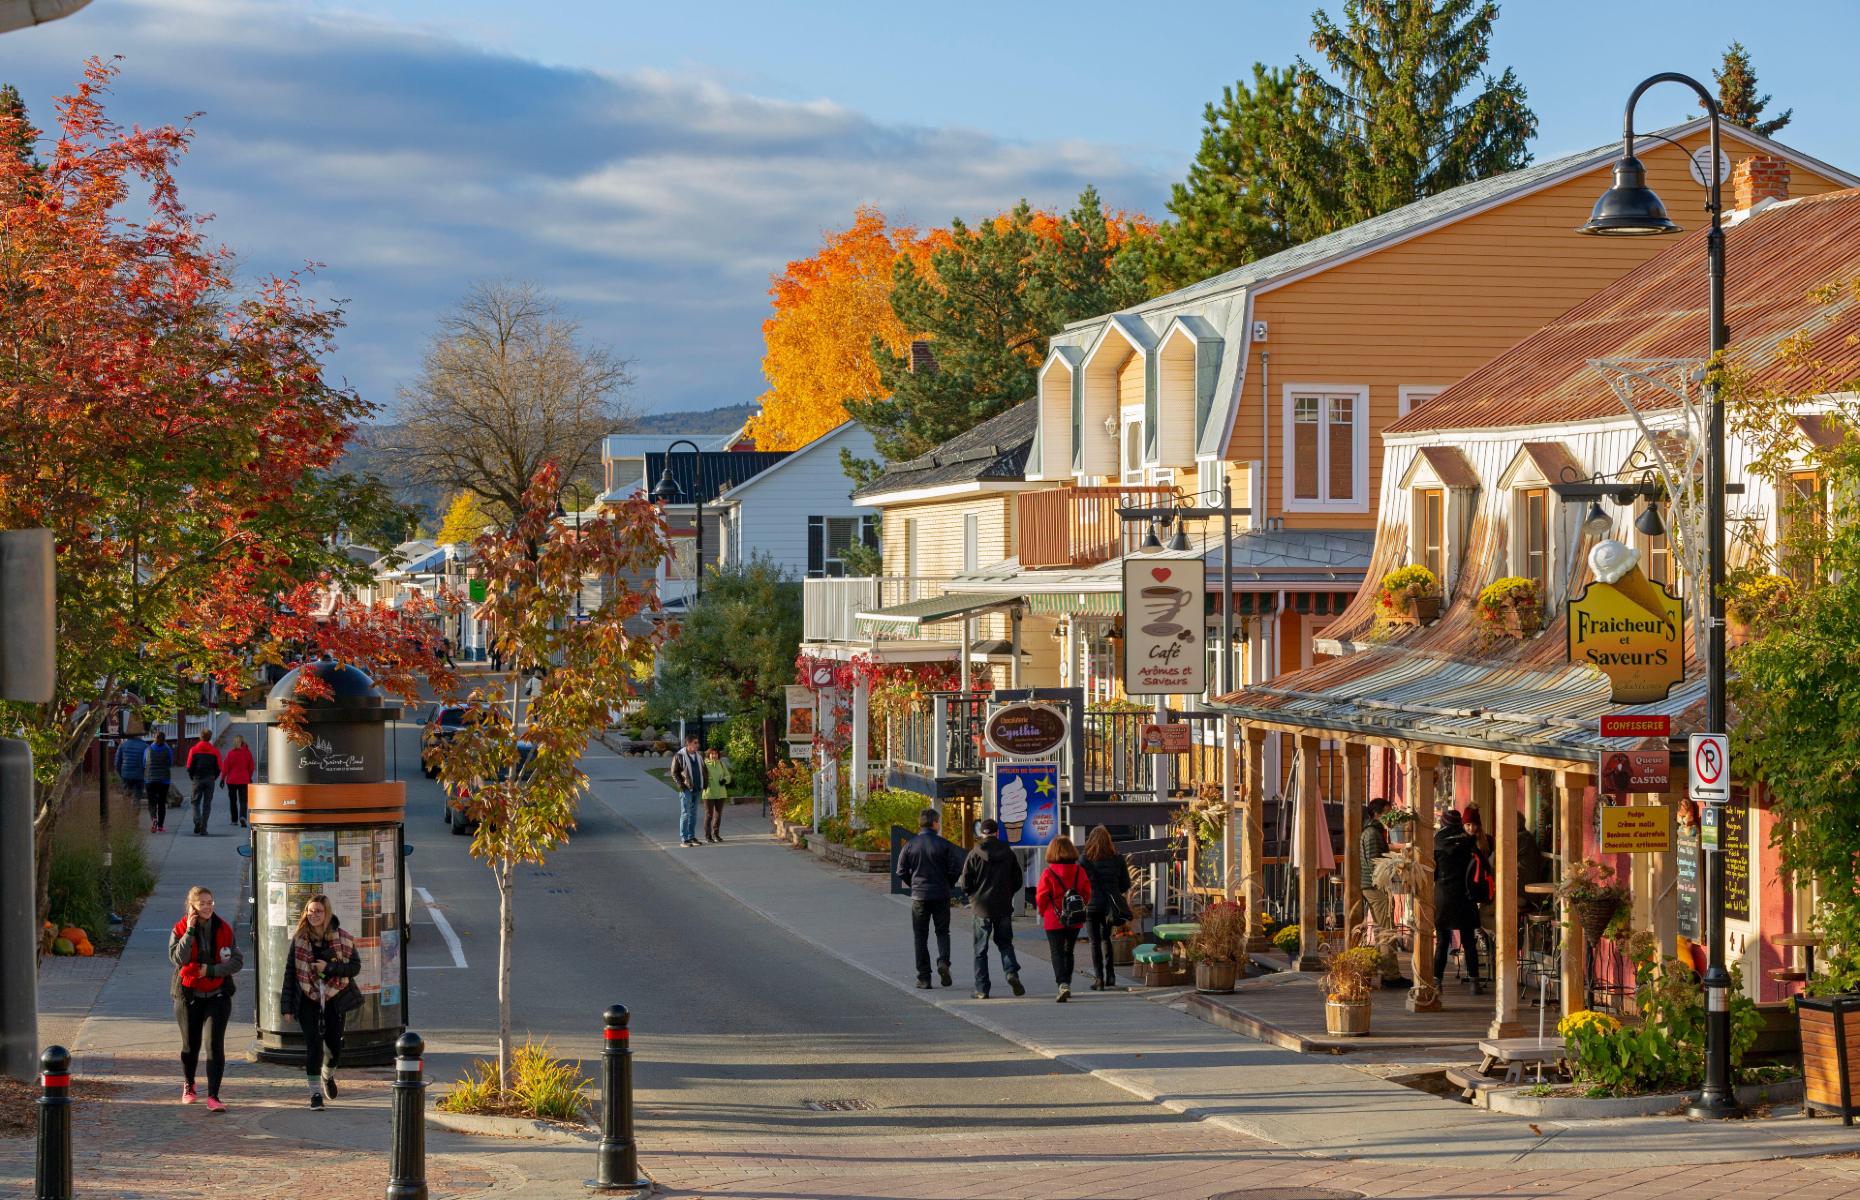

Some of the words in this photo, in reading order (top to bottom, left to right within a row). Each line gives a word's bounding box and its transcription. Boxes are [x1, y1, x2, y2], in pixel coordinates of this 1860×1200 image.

[1620, 636, 1630, 644] et
[1149, 642, 1181, 665] Café
[1138, 665, 1179, 676] Arômes
[1182, 666, 1192, 675] et
[1607, 721, 1664, 730] CONFISERIE
[996, 724, 1040, 741] Cynthia
[1636, 756, 1664, 765] Queue
[1706, 750, 1715, 773] P
[1630, 776, 1668, 784] CASTOR
[1639, 820, 1655, 828] molle
